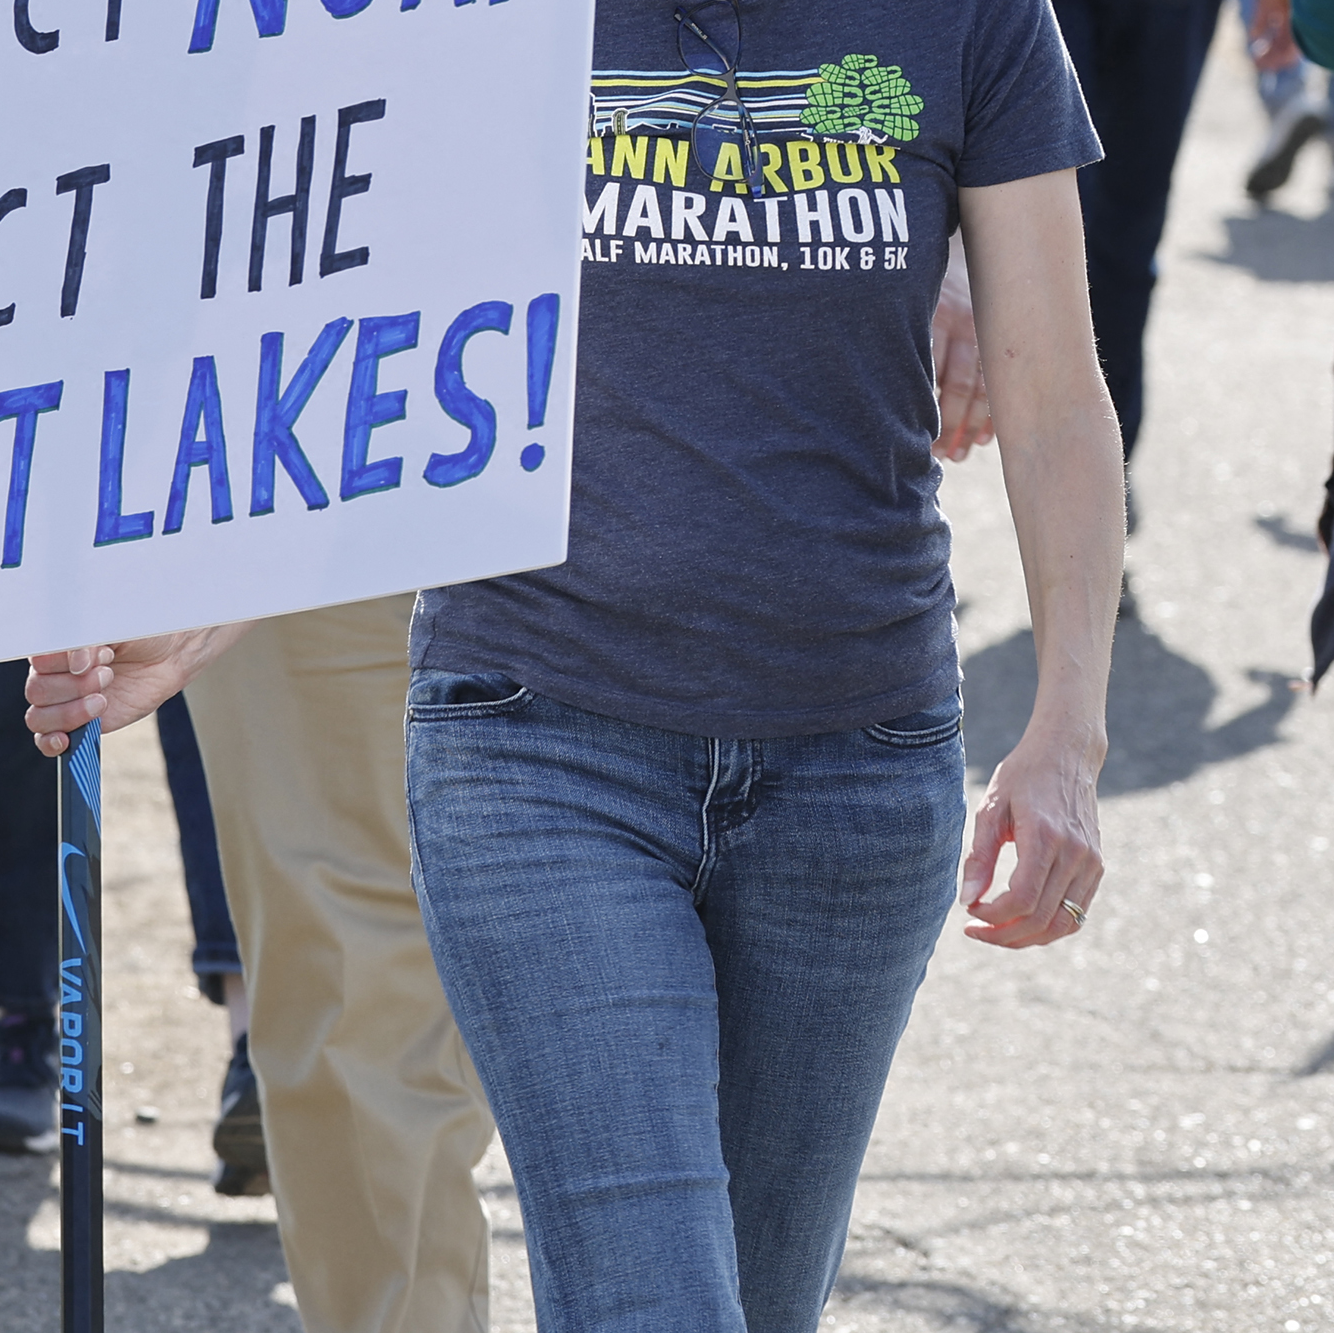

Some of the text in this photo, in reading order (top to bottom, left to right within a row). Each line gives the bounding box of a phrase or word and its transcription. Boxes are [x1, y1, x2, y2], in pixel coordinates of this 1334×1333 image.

[192, 98, 387, 300] THE
[582, 181, 909, 243] MARATHON
[586, 134, 901, 194] ANN ARBOR
[580, 238, 909, 271] ALF MARATHON, 10K & 5K
[92, 292, 560, 548] LAKES!
[59, 957, 84, 1094] VAPOR
